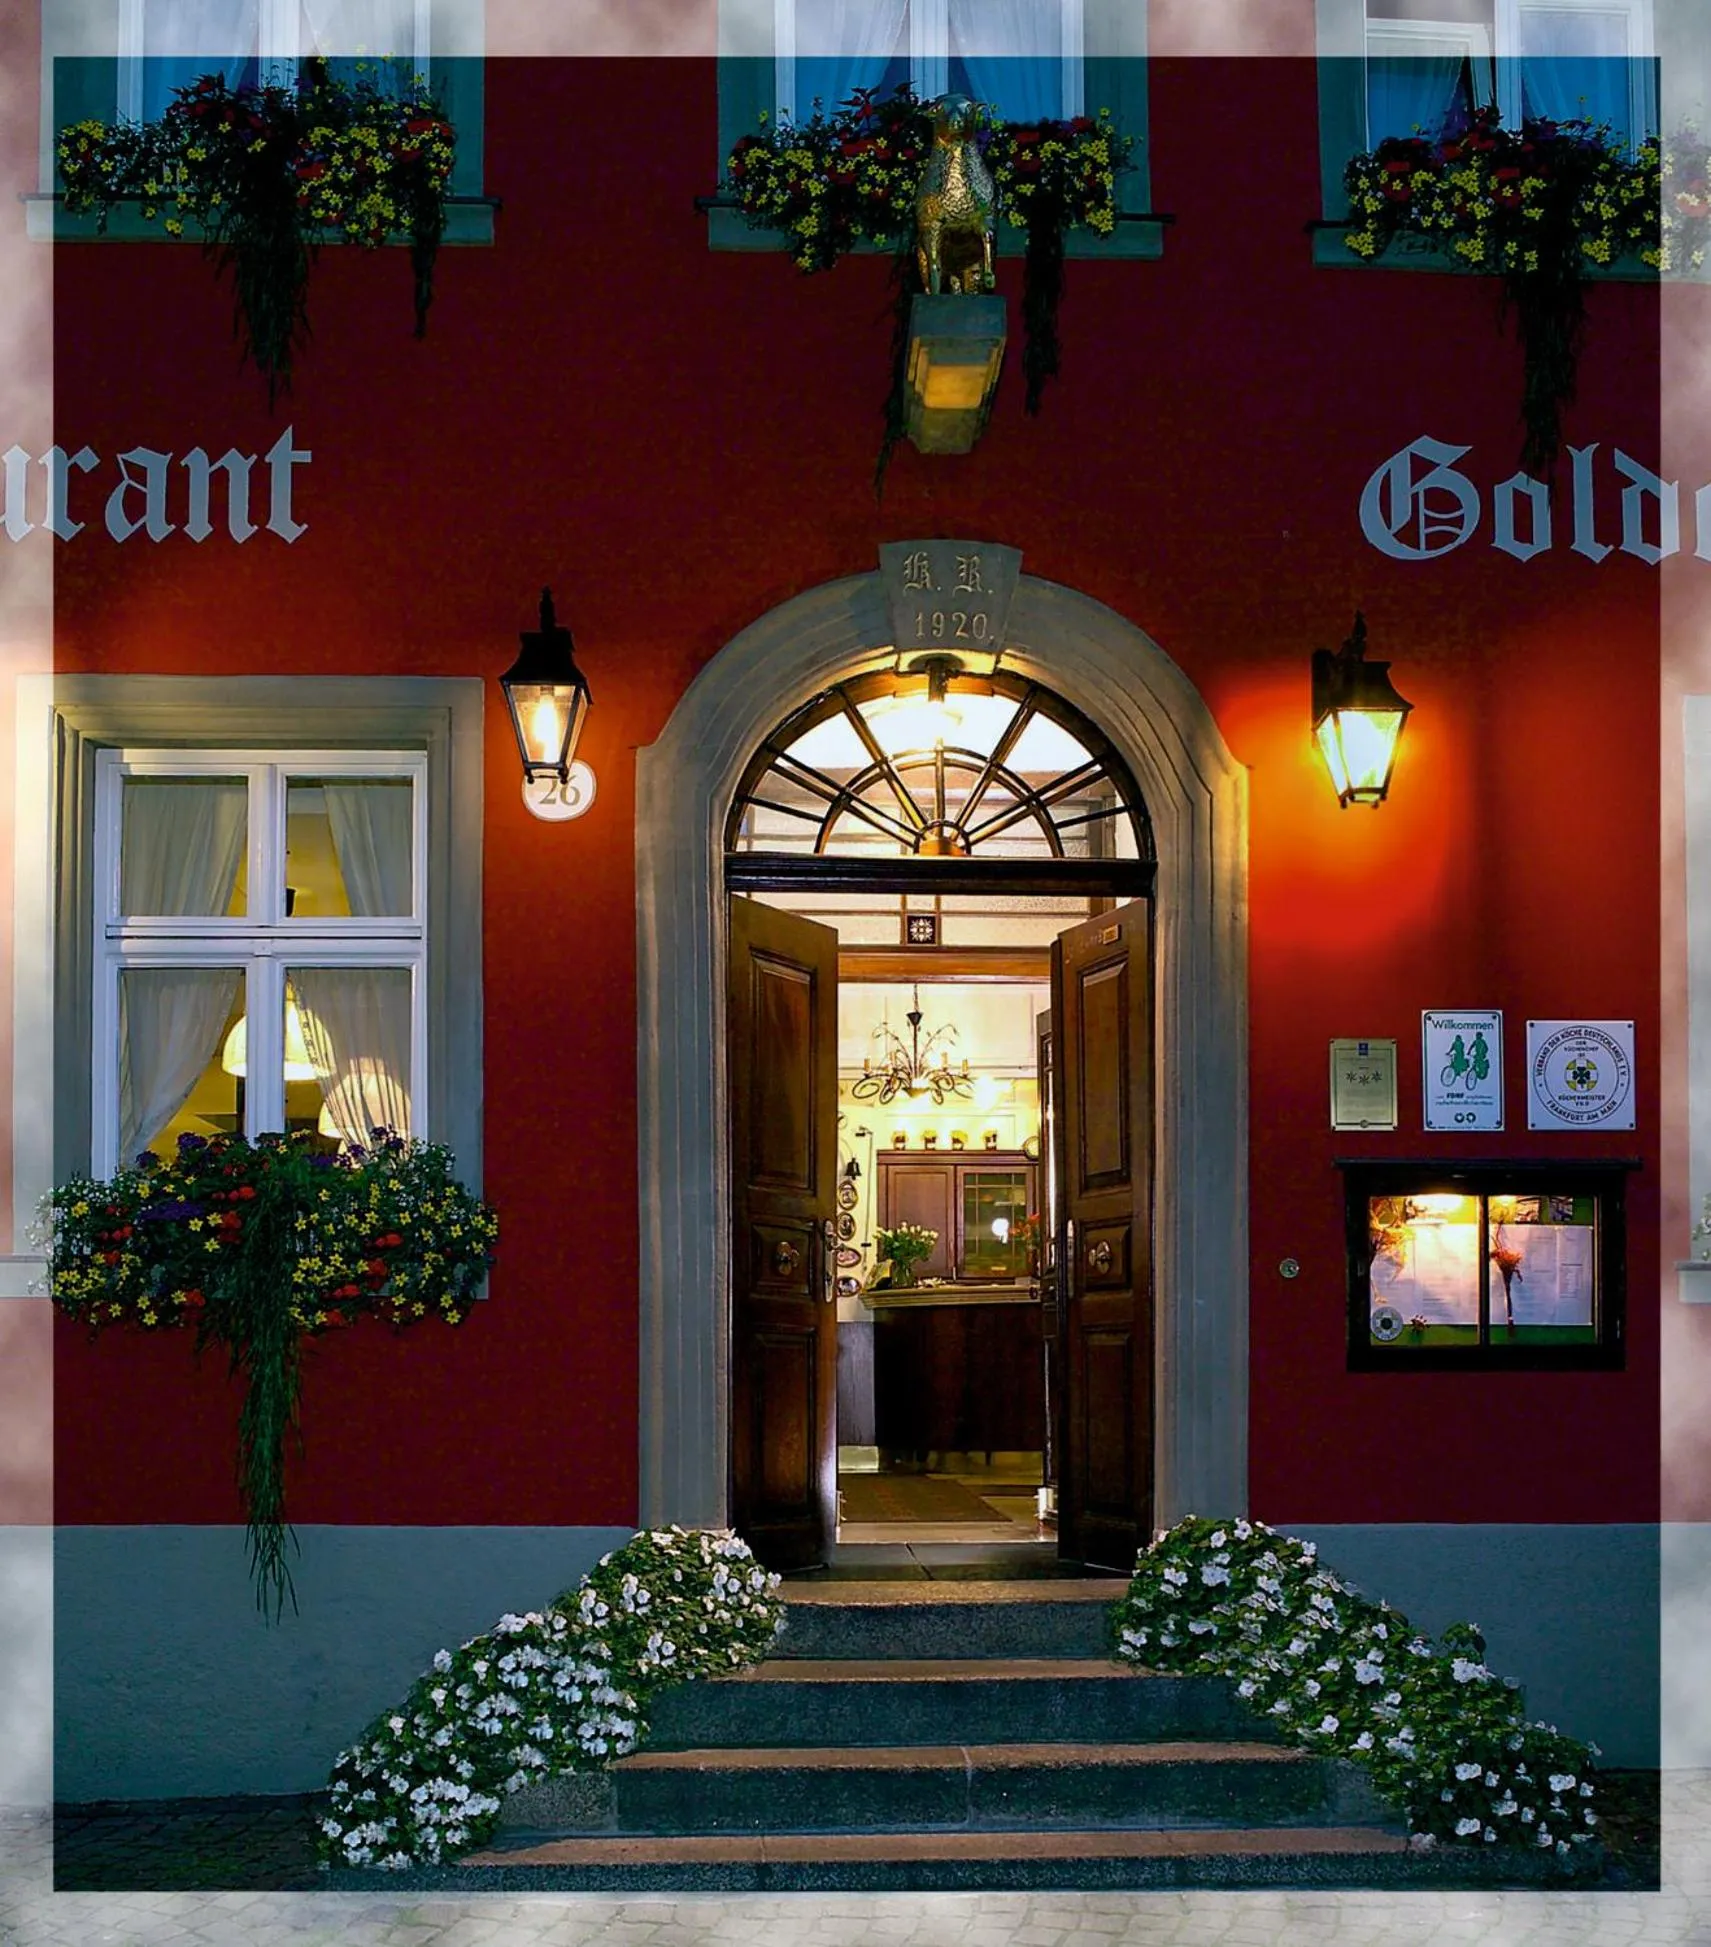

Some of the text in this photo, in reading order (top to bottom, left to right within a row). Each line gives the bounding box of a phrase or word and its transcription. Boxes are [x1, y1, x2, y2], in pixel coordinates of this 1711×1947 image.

[1432, 1018, 1495, 1031] Willkommen
[1546, 1100, 1618, 1121] FRANKFURT AM MAIN
